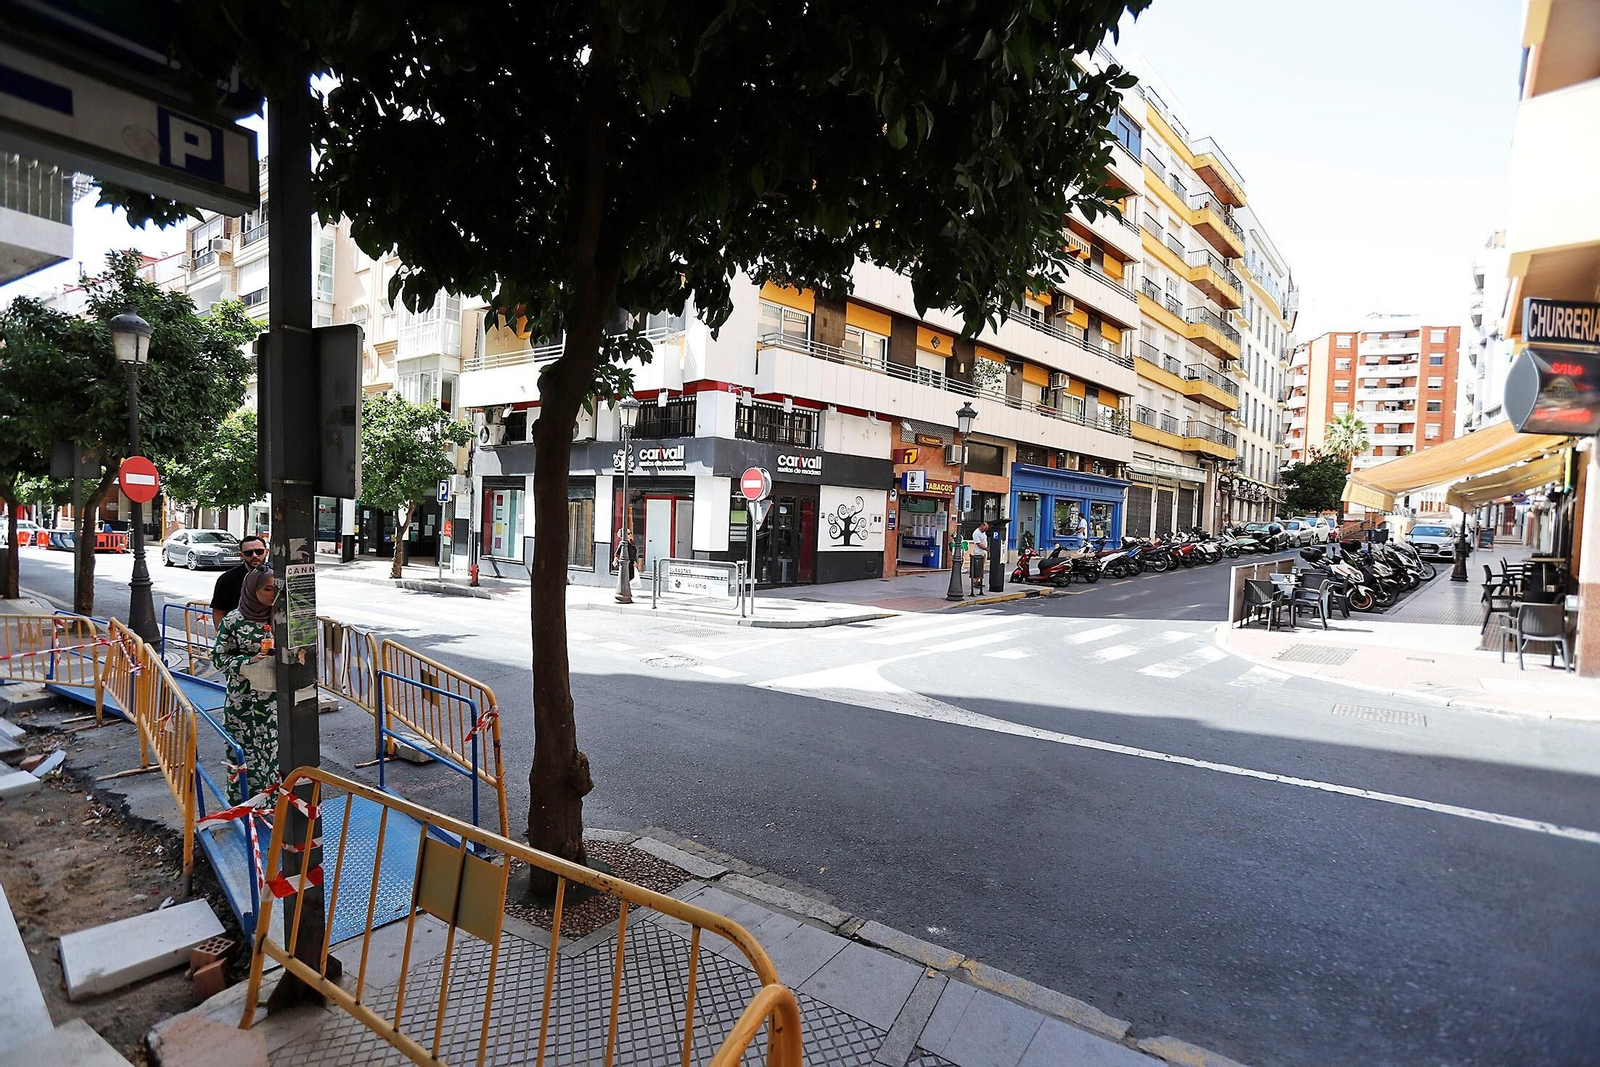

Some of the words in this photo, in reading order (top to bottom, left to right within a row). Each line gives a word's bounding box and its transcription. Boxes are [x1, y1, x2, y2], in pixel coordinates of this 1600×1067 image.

[168, 115, 213, 169] P
[639, 445, 685, 460] carivall
[777, 453, 822, 469] carivall
[439, 482, 447, 500] P
[925, 481, 953, 492] TABACOS
